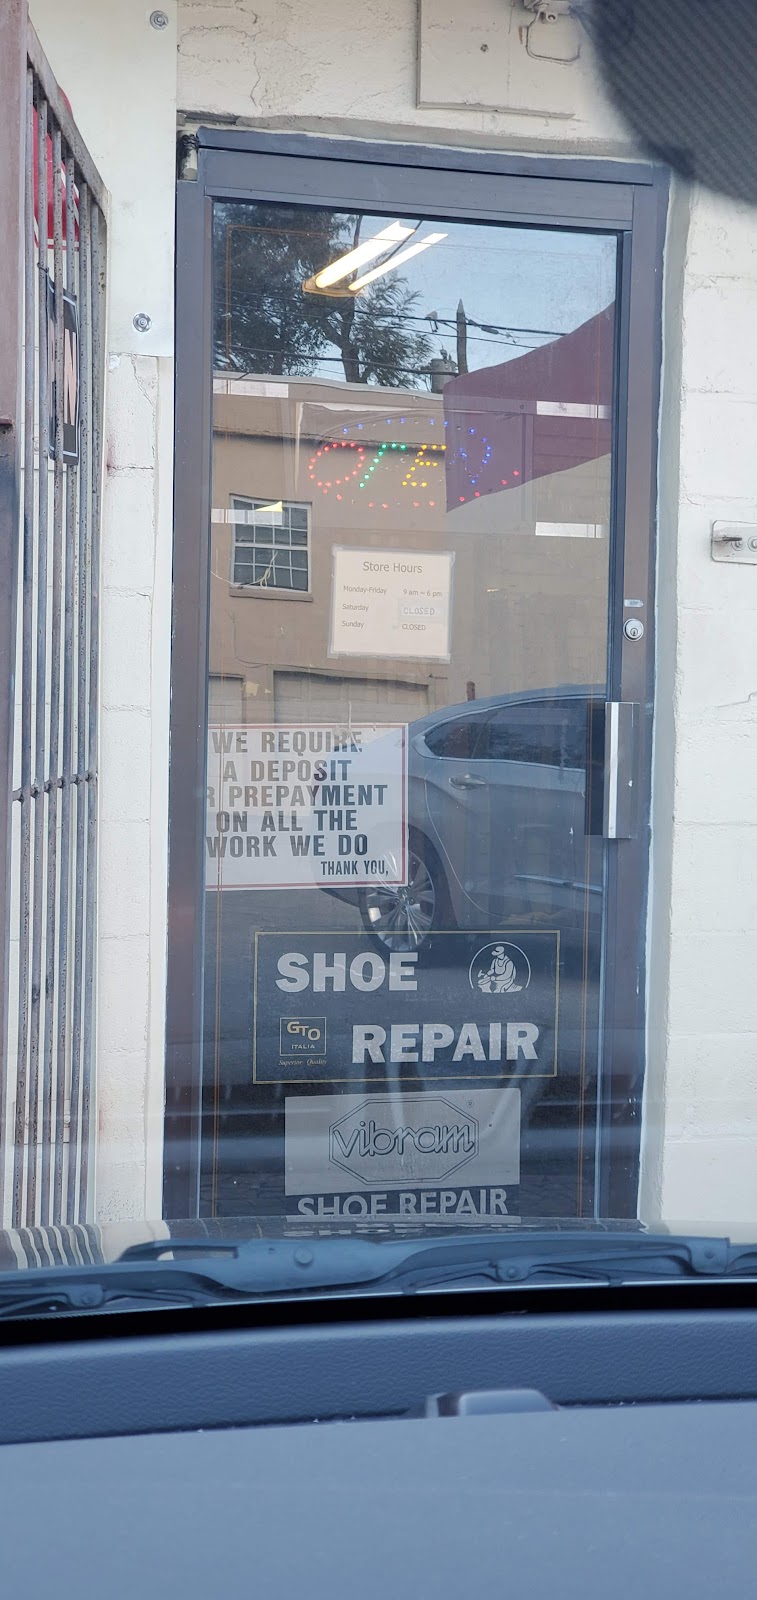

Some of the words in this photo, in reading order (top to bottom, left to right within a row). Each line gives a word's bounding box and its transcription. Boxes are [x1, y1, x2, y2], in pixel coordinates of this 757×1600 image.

[362, 561, 390, 572] Store
[393, 562, 423, 574] Hours
[343, 585, 388, 595] Monday-Friday
[342, 603, 369, 612] Saturday
[403, 607, 435, 615] CLOSED
[341, 620, 365, 629] Sunday
[401, 623, 427, 631] CLOSED
[212, 731, 248, 753] WE
[261, 731, 363, 756] REQUIRE
[222, 760, 238, 782] A
[250, 759, 352, 782] DEPOSIT
[206, 787, 216, 807] R
[228, 784, 388, 808] PREPAYMENT
[215, 810, 248, 833] ON
[260, 810, 303, 832] ALL
[313, 809, 358, 831] THE
[206, 835, 278, 858] WORK
[289, 834, 326, 857] WE
[338, 834, 368, 856] DO
[320, 860, 359, 876] THANK
[363, 859, 389, 877] YOU,
[275, 952, 419, 993] SHOE
[286, 1021, 321, 1041] GTO
[352, 1022, 540, 1064] REPAIR
[278, 1059, 304, 1067] Superior
[333, 1120, 476, 1158] vibram
[297, 1194, 388, 1216] SHOE
[399, 1188, 509, 1215] REPAIR
